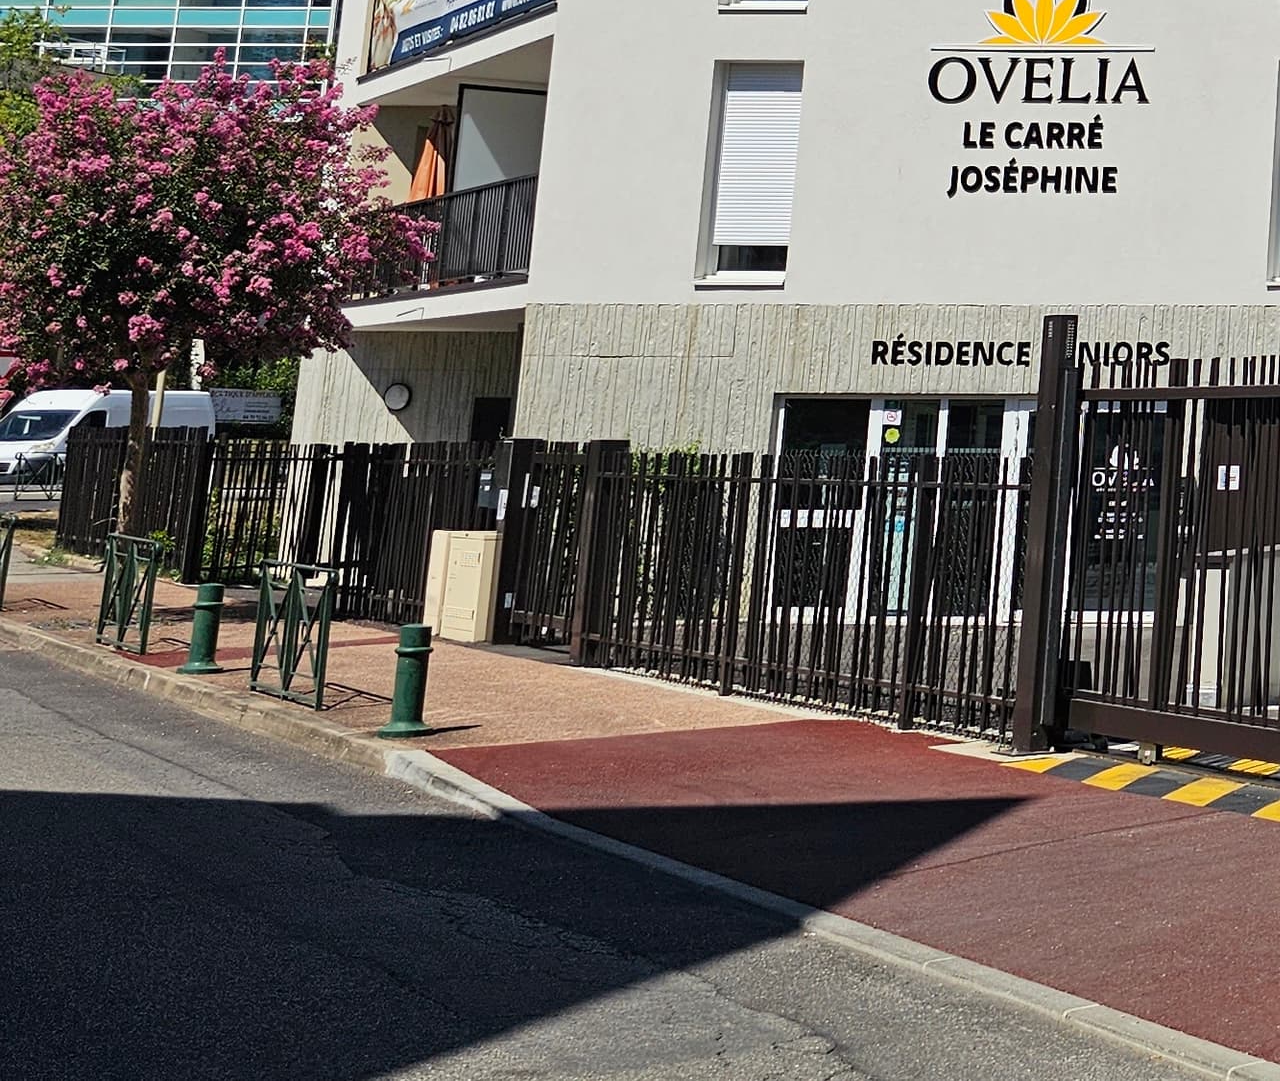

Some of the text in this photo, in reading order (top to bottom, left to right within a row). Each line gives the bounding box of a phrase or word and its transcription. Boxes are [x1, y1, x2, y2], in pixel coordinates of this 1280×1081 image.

[927, 56, 1151, 105] OVELIA
[962, 114, 1104, 150] LE CARRÉ
[946, 157, 1119, 199] JOSÉPHINE
[871, 333, 1171, 368] RÉSIDENCE NIORS
